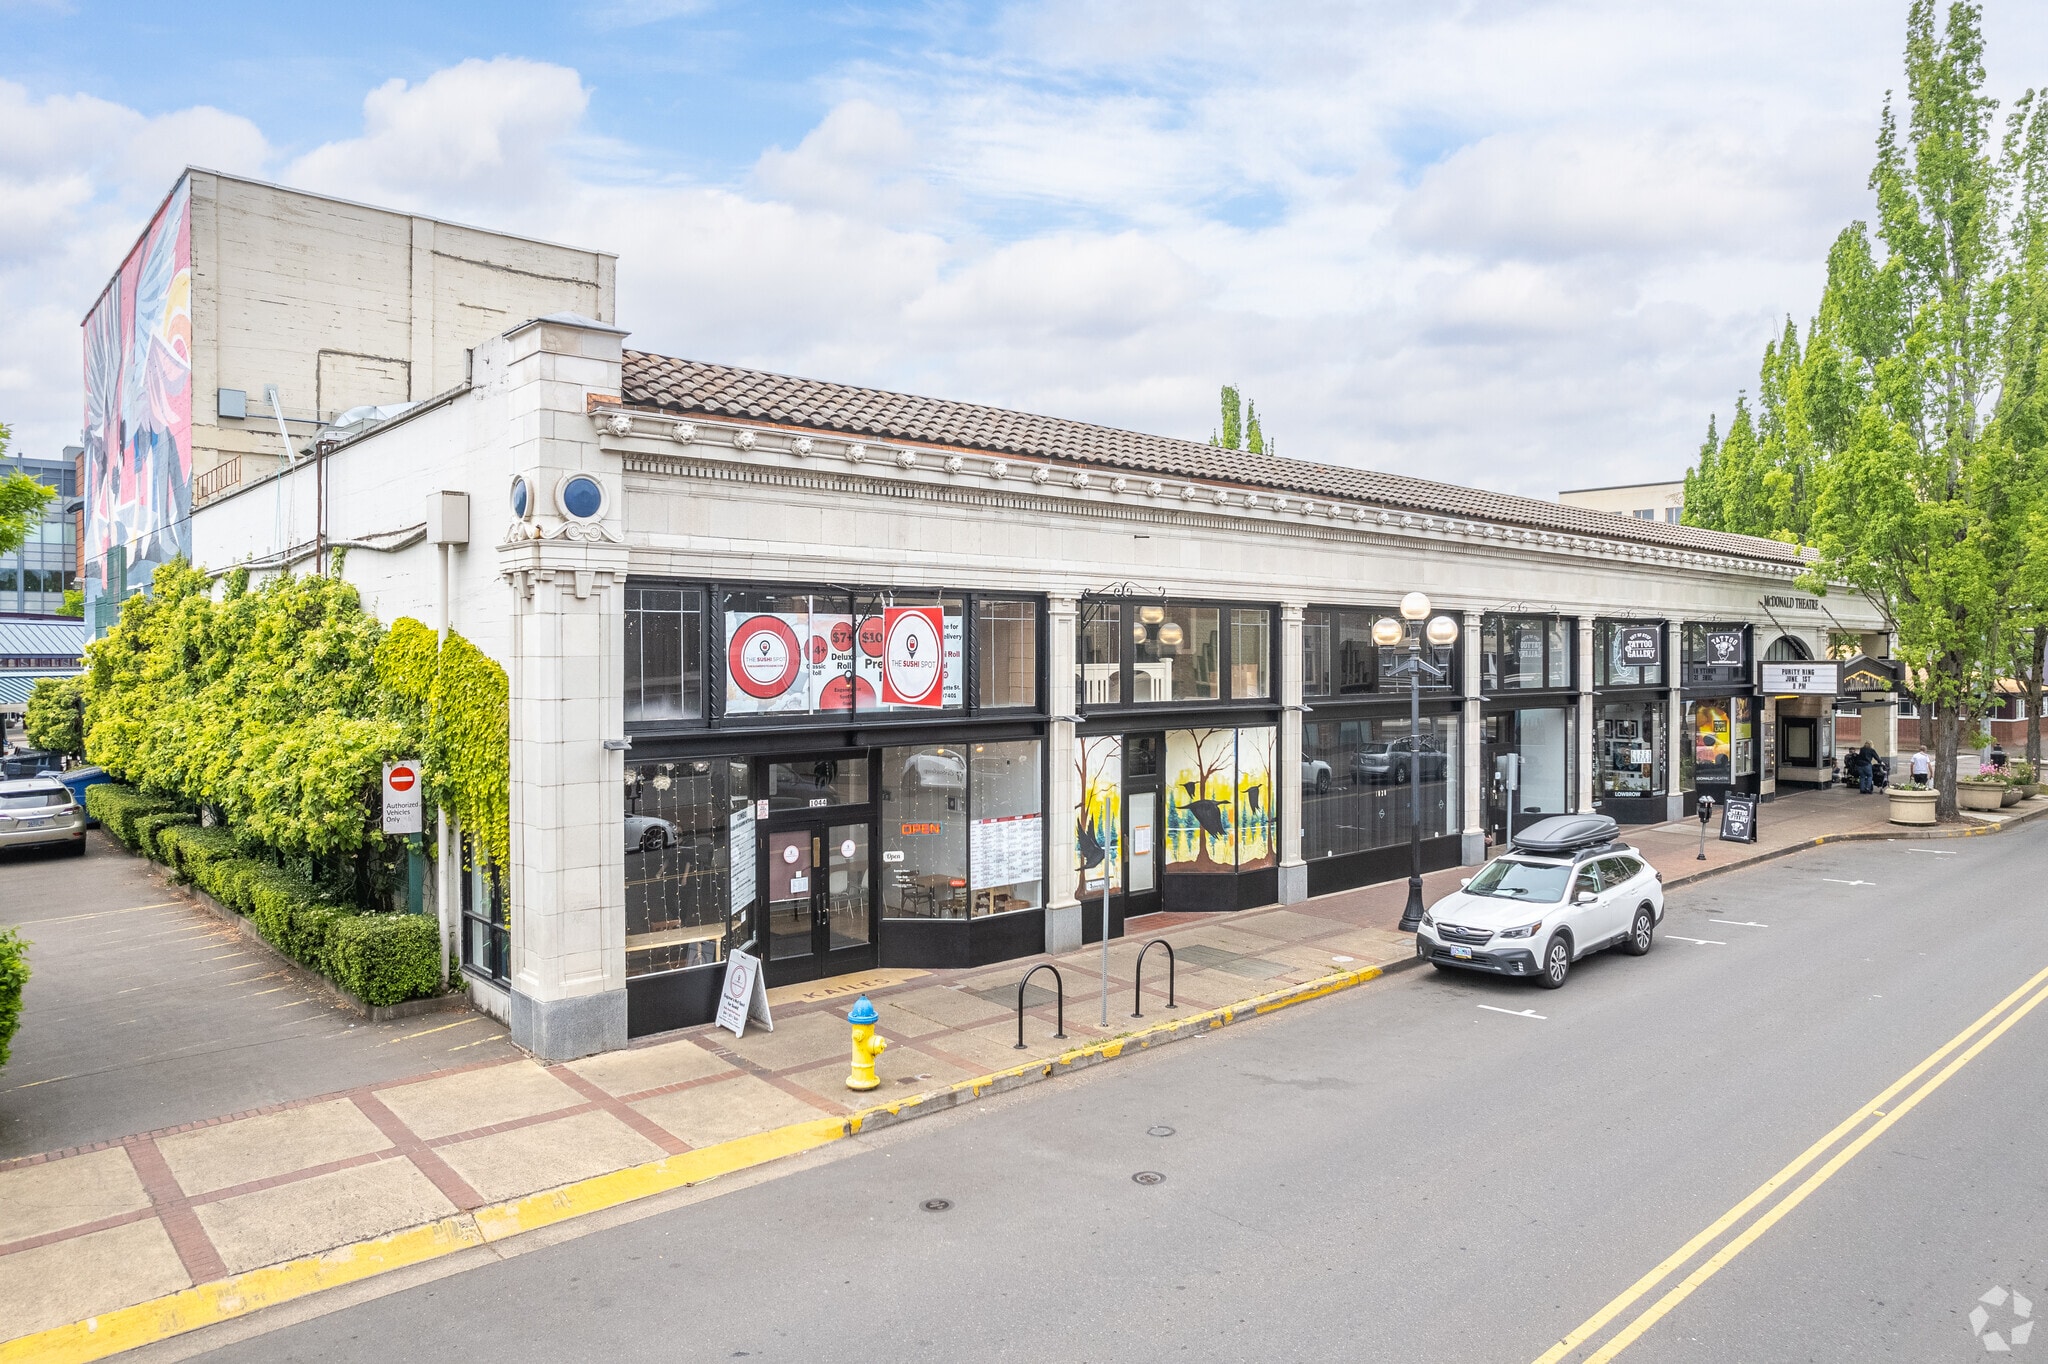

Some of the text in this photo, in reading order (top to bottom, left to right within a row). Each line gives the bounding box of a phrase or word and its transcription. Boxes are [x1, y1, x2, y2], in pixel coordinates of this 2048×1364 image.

[1795, 598, 1819, 610] THEATRE
[1628, 640, 1653, 648] TATTOO
[1711, 635, 1739, 646] TATTOO
[813, 645, 826, 655] 4+
[1627, 649, 1656, 659] GALLERY
[831, 653, 854, 661] Delux
[837, 662, 852, 670] Roll
[865, 658, 883, 669] Pre
[892, 660, 902, 668] THE
[903, 660, 920, 668] SUSHI
[921, 660, 936, 669] SPOT
[1782, 668, 1815, 676] PURITY RING
[1785, 675, 1798, 683] JUNE
[810, 799, 828, 807] 1044
[901, 823, 941, 835] OPEN
